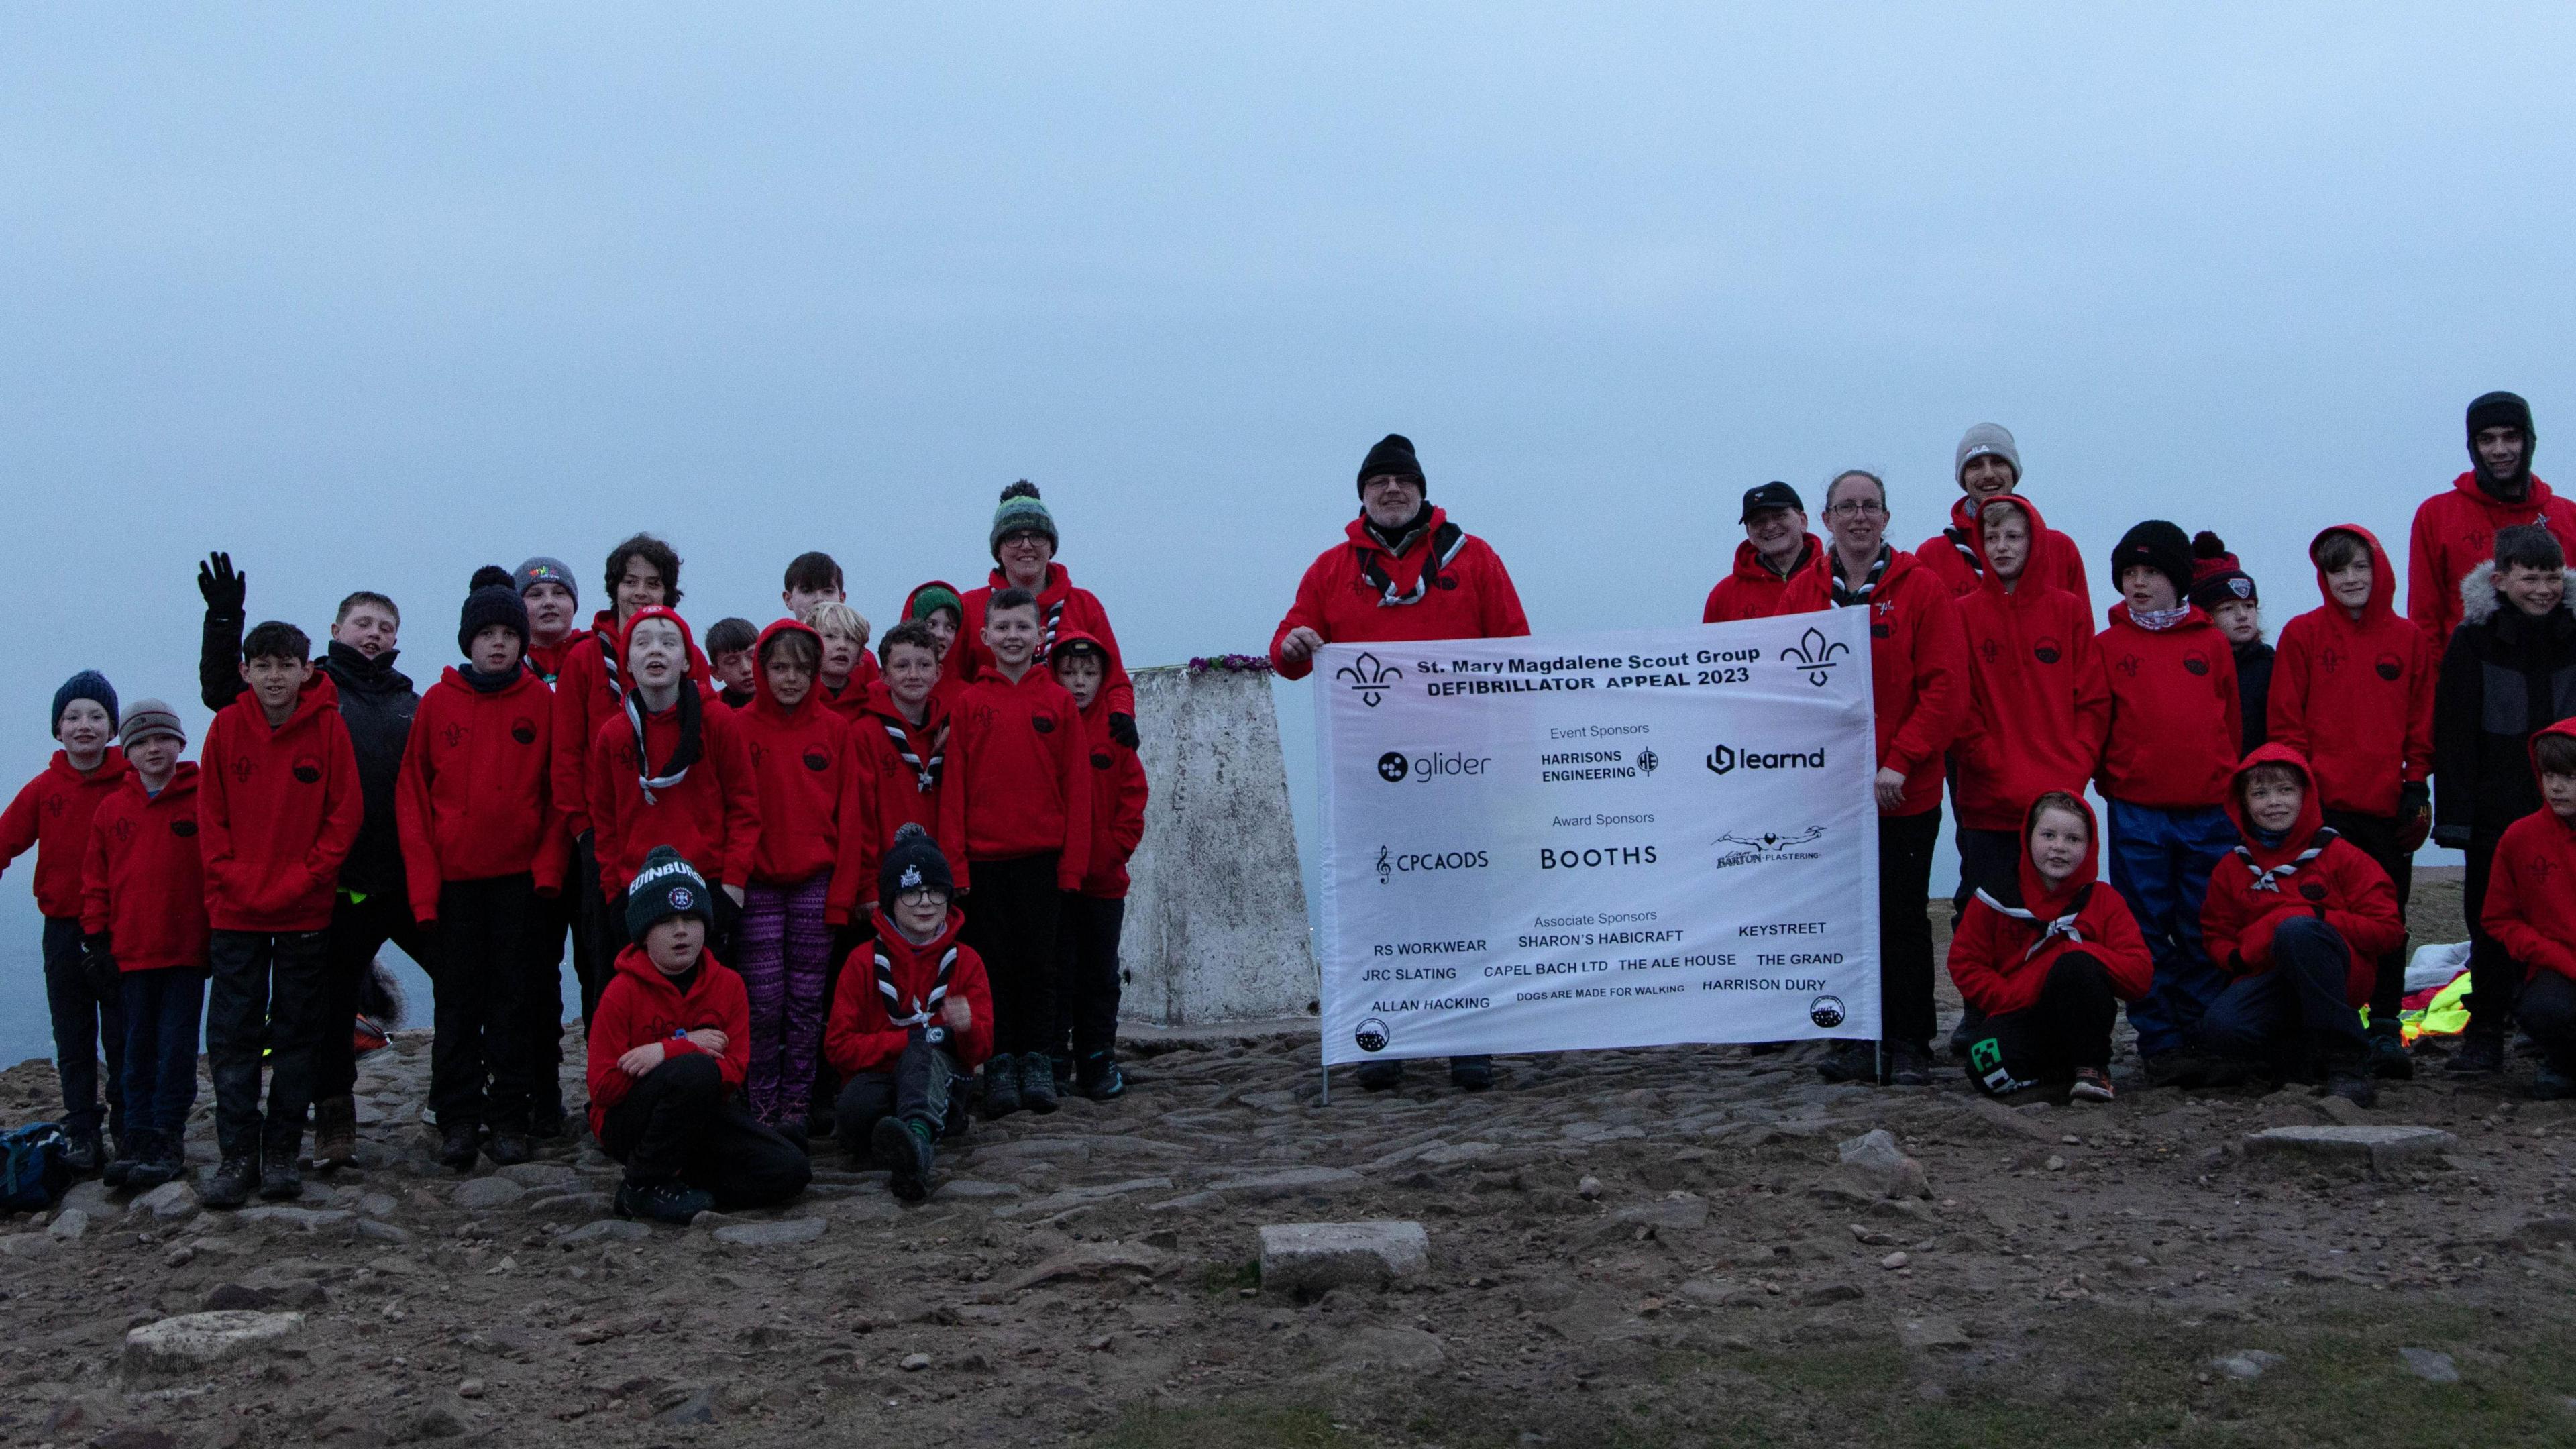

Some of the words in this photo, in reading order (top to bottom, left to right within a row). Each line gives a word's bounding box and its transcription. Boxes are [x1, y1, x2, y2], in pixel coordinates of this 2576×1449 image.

[1417, 661, 1445, 674] St.
[1452, 660, 1503, 674] Mary
[1509, 655, 1622, 674] Magdalene
[1629, 653, 1689, 669] Scout
[1697, 649, 1760, 664] Group
[1428, 678, 1595, 696] DEFIBRILLATOR
[1607, 673, 1690, 688] APPEAL
[1698, 667, 1749, 685] 2023
[1550, 727, 1586, 739] Event
[1590, 724, 1650, 739] Sponsors
[1542, 751, 1621, 765] HARRISONS
[1741, 747, 1824, 769] learnd
[1415, 752, 1491, 783] glider
[1543, 767, 1635, 782] ENGINEERING
[1552, 815, 1591, 826] Award
[1596, 814, 1654, 827] Sponsors
[1397, 851, 1489, 871] CPCAODS
[1541, 846, 1656, 869] BOOTHS
[1717, 853, 1762, 869] BARTON
[629, 861, 706, 896] EDINBURG
[1534, 915, 1594, 927] Associate
[1599, 912, 1657, 926] Sponsors
[1599, 930, 1683, 944] HABICRAFT
[1739, 922, 1826, 936] KEYSTREET
[1375, 945, 1393, 956] RS
[1397, 940, 1487, 955] WORKWEAR
[1619, 959, 1646, 971] THE
[1651, 957, 1679, 968] ALE
[1685, 954, 1736, 966] HOUSE
[1757, 955, 1785, 965] THE
[1790, 953, 1843, 965] GRAND
[1362, 969, 1391, 981] JRC
[1395, 968, 1456, 980] SLATING
[1484, 965, 1532, 977] CAPEL
[1536, 963, 1576, 975] BACH
[1582, 961, 1608, 972] LTD
[1703, 979, 1780, 990] HARRISON
[1786, 979, 1826, 991] DURY
[1517, 992, 1548, 1002] DOGS
[1550, 990, 1572, 998] ARE
[1576, 988, 1606, 998] MADE
[1610, 987, 1632, 996] FOR
[1635, 985, 1684, 995] WALKING
[1371, 1000, 1419, 1012] ALLAN
[1424, 998, 1489, 1010] HACKING
